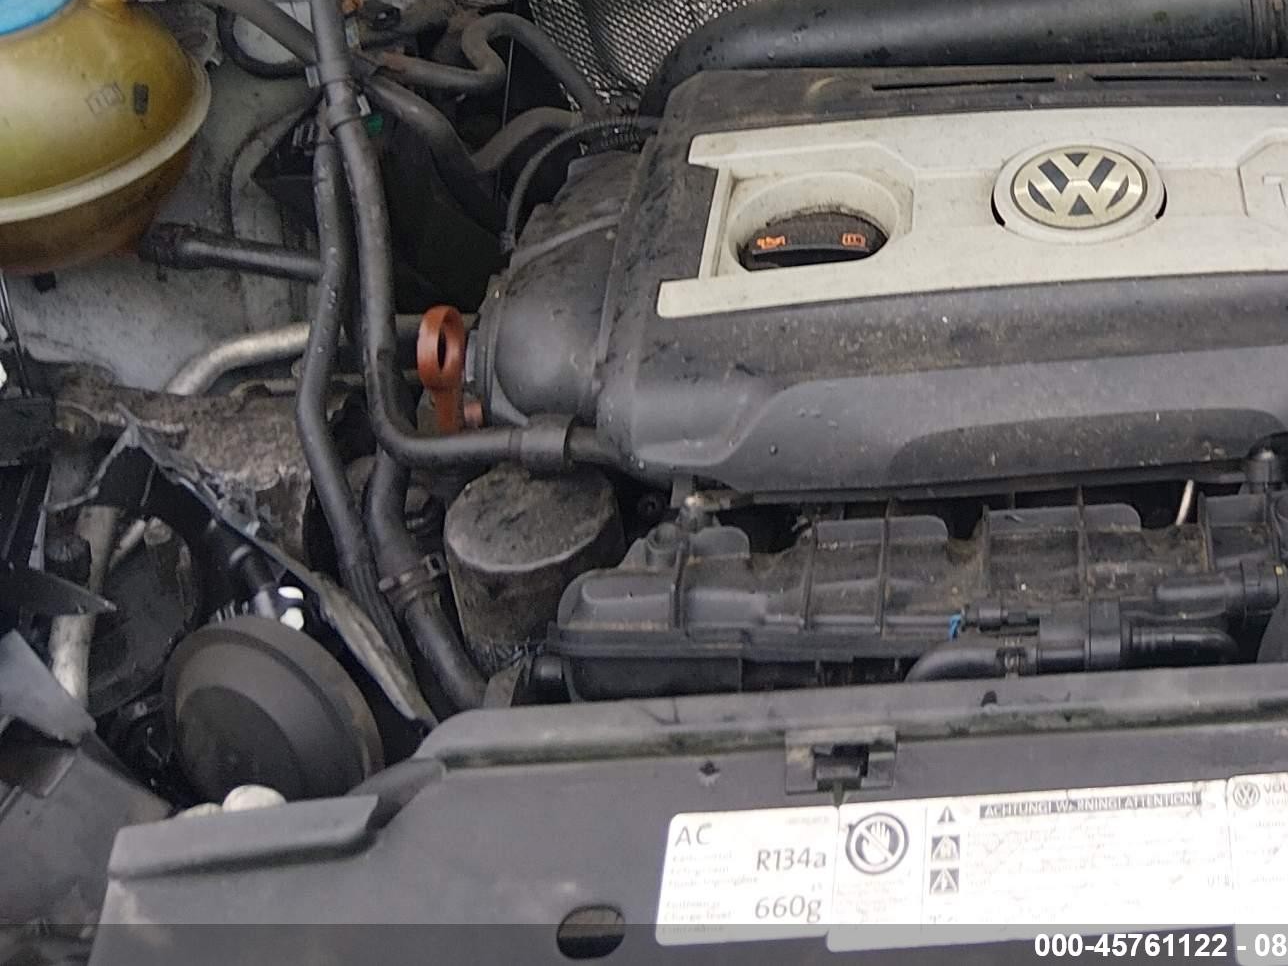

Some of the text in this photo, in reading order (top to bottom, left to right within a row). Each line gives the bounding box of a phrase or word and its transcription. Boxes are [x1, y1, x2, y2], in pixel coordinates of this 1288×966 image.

[674, 822, 713, 847] AC
[756, 846, 828, 872] R134a
[754, 894, 823, 925] 660g
